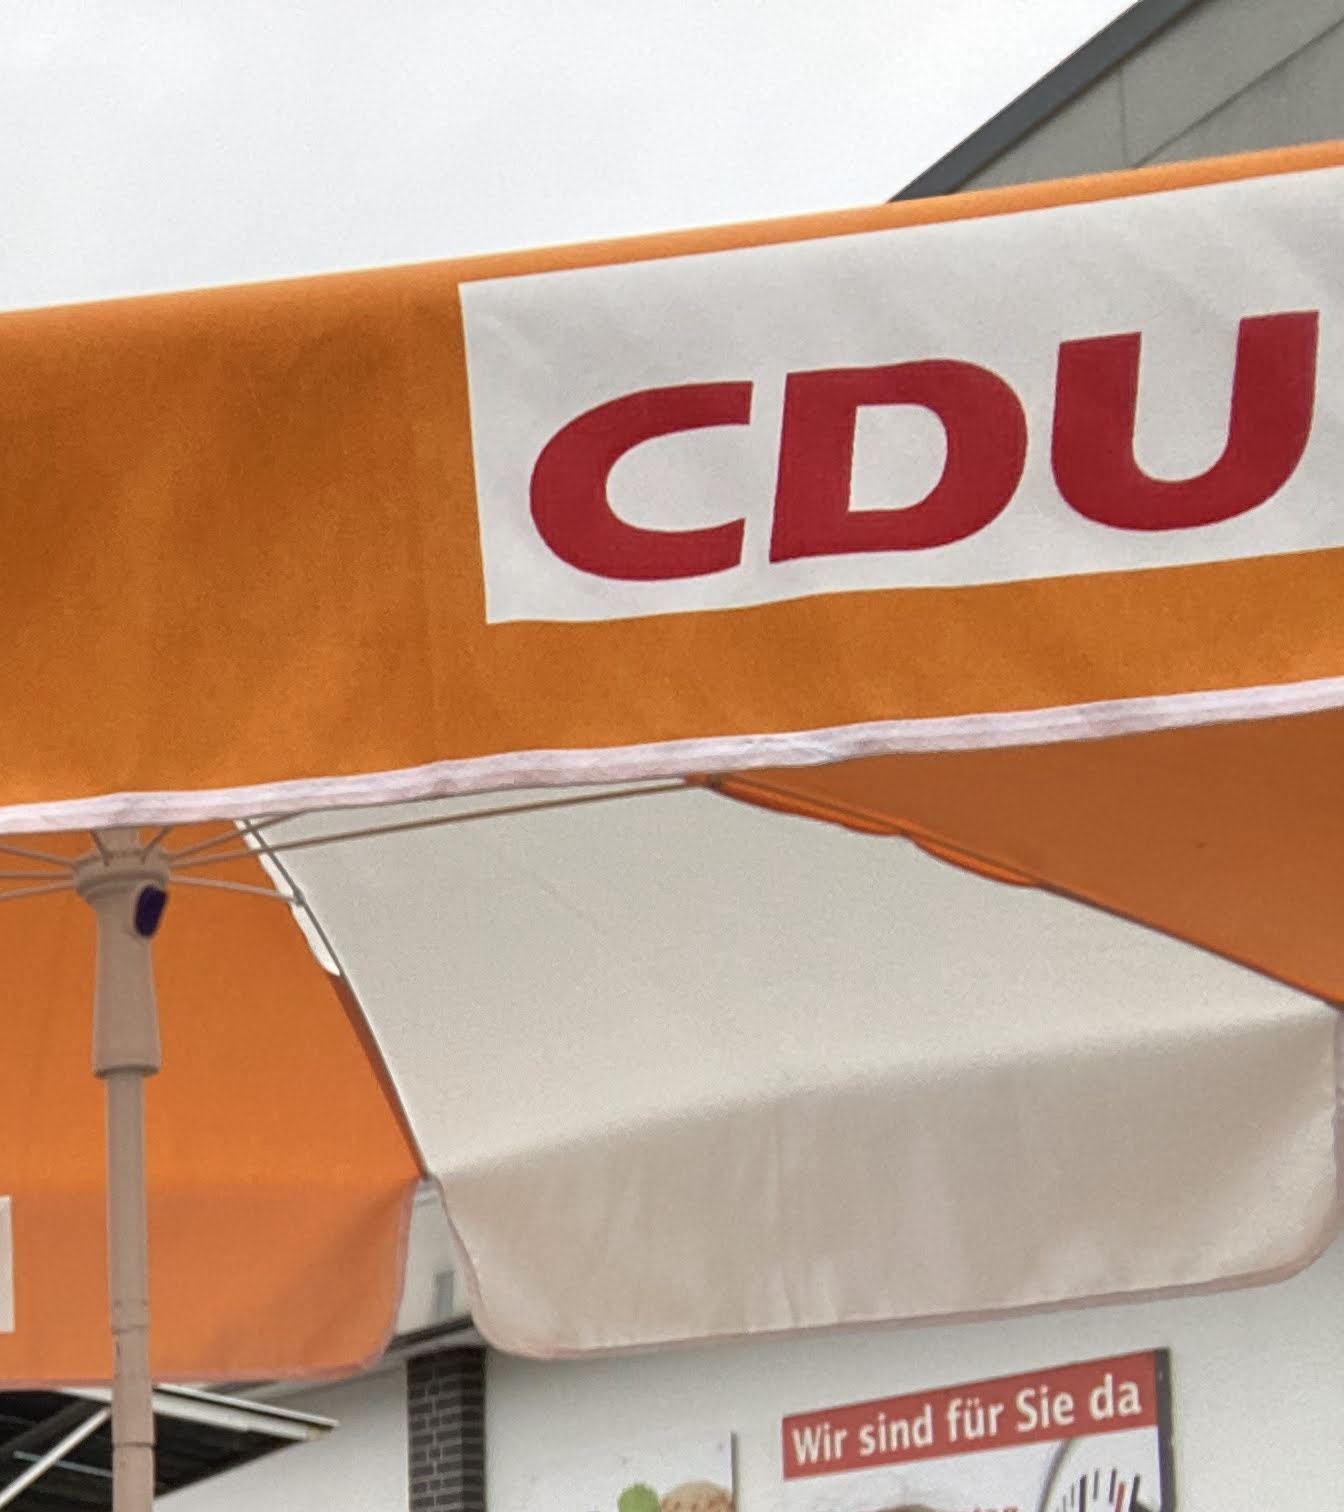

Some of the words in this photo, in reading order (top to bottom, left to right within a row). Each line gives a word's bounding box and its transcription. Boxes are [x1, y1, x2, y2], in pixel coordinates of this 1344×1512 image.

[529, 309, 1319, 582] CDU
[791, 1423, 846, 1465] Wir
[858, 1404, 934, 1457] sind
[946, 1397, 1005, 1443] für
[1015, 1383, 1075, 1433] Sie
[1088, 1372, 1142, 1421] da
